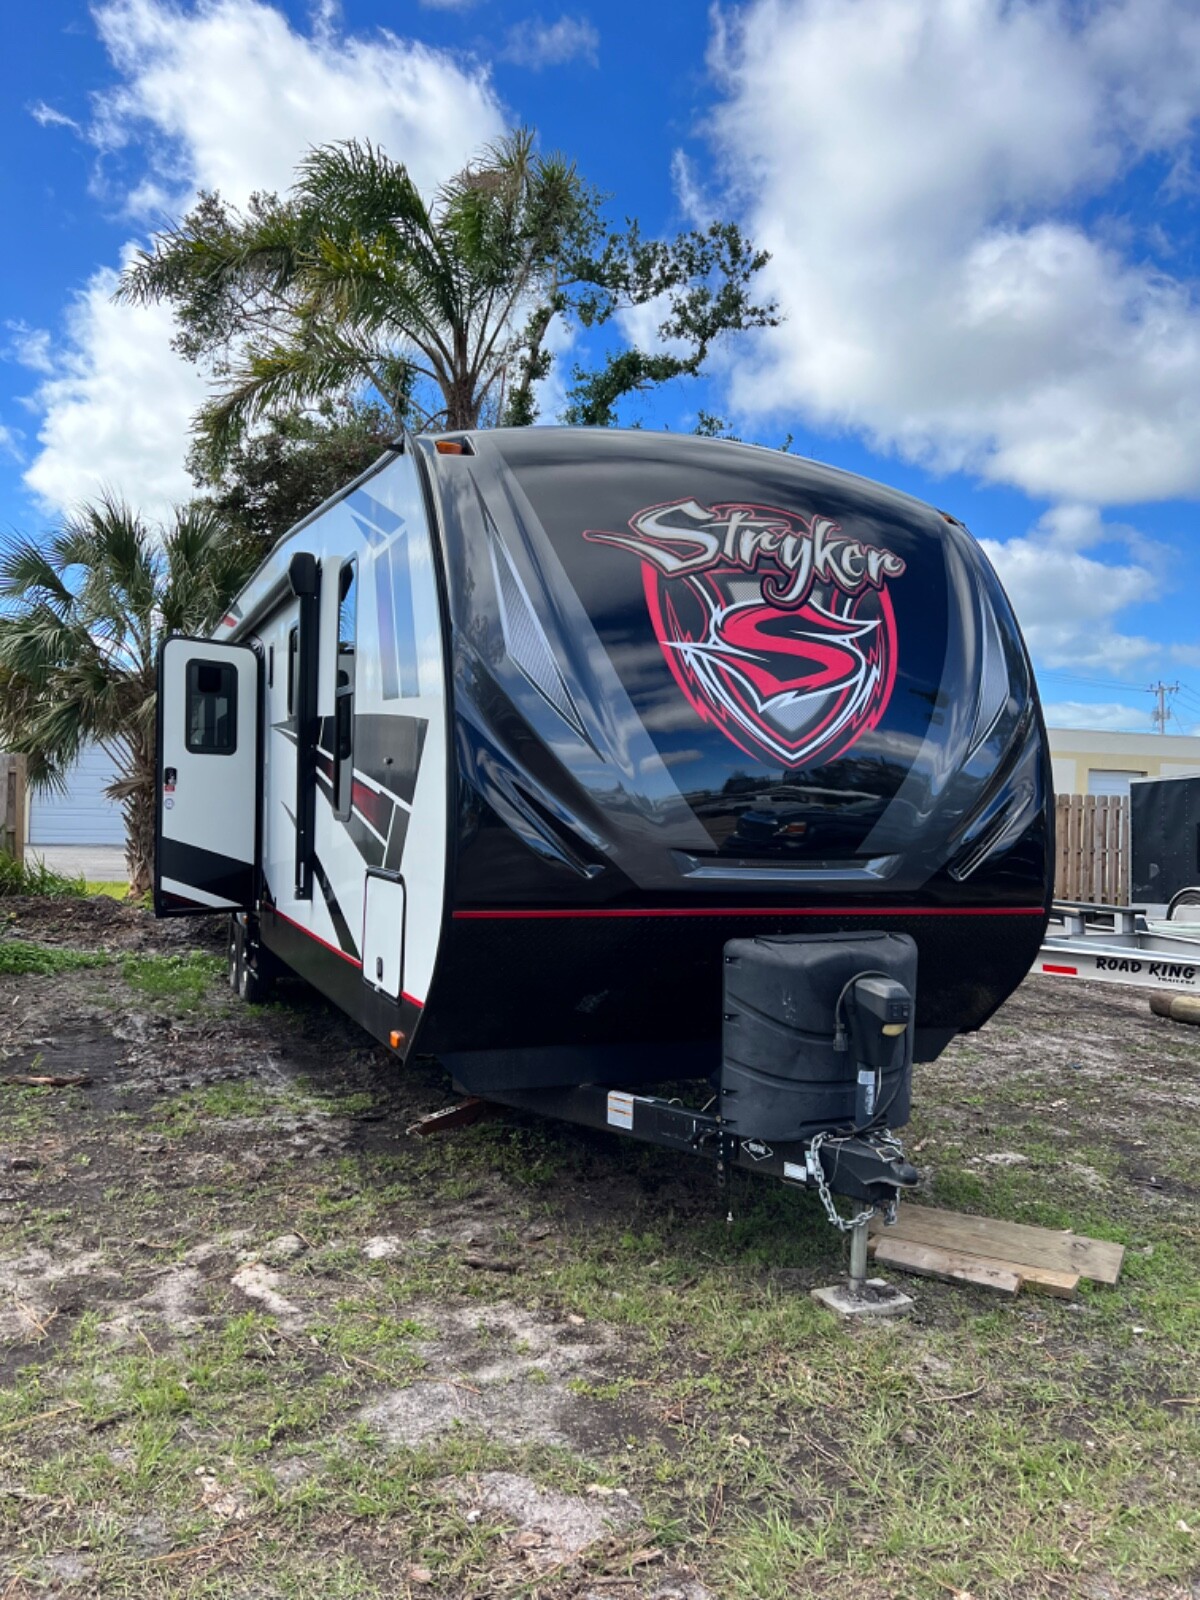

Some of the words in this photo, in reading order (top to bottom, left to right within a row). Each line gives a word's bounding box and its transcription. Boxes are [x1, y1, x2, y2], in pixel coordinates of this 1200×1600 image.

[584, 498, 906, 610] Stryker
[1096, 956, 1142, 973] ROAD
[1149, 963, 1196, 979] KING
